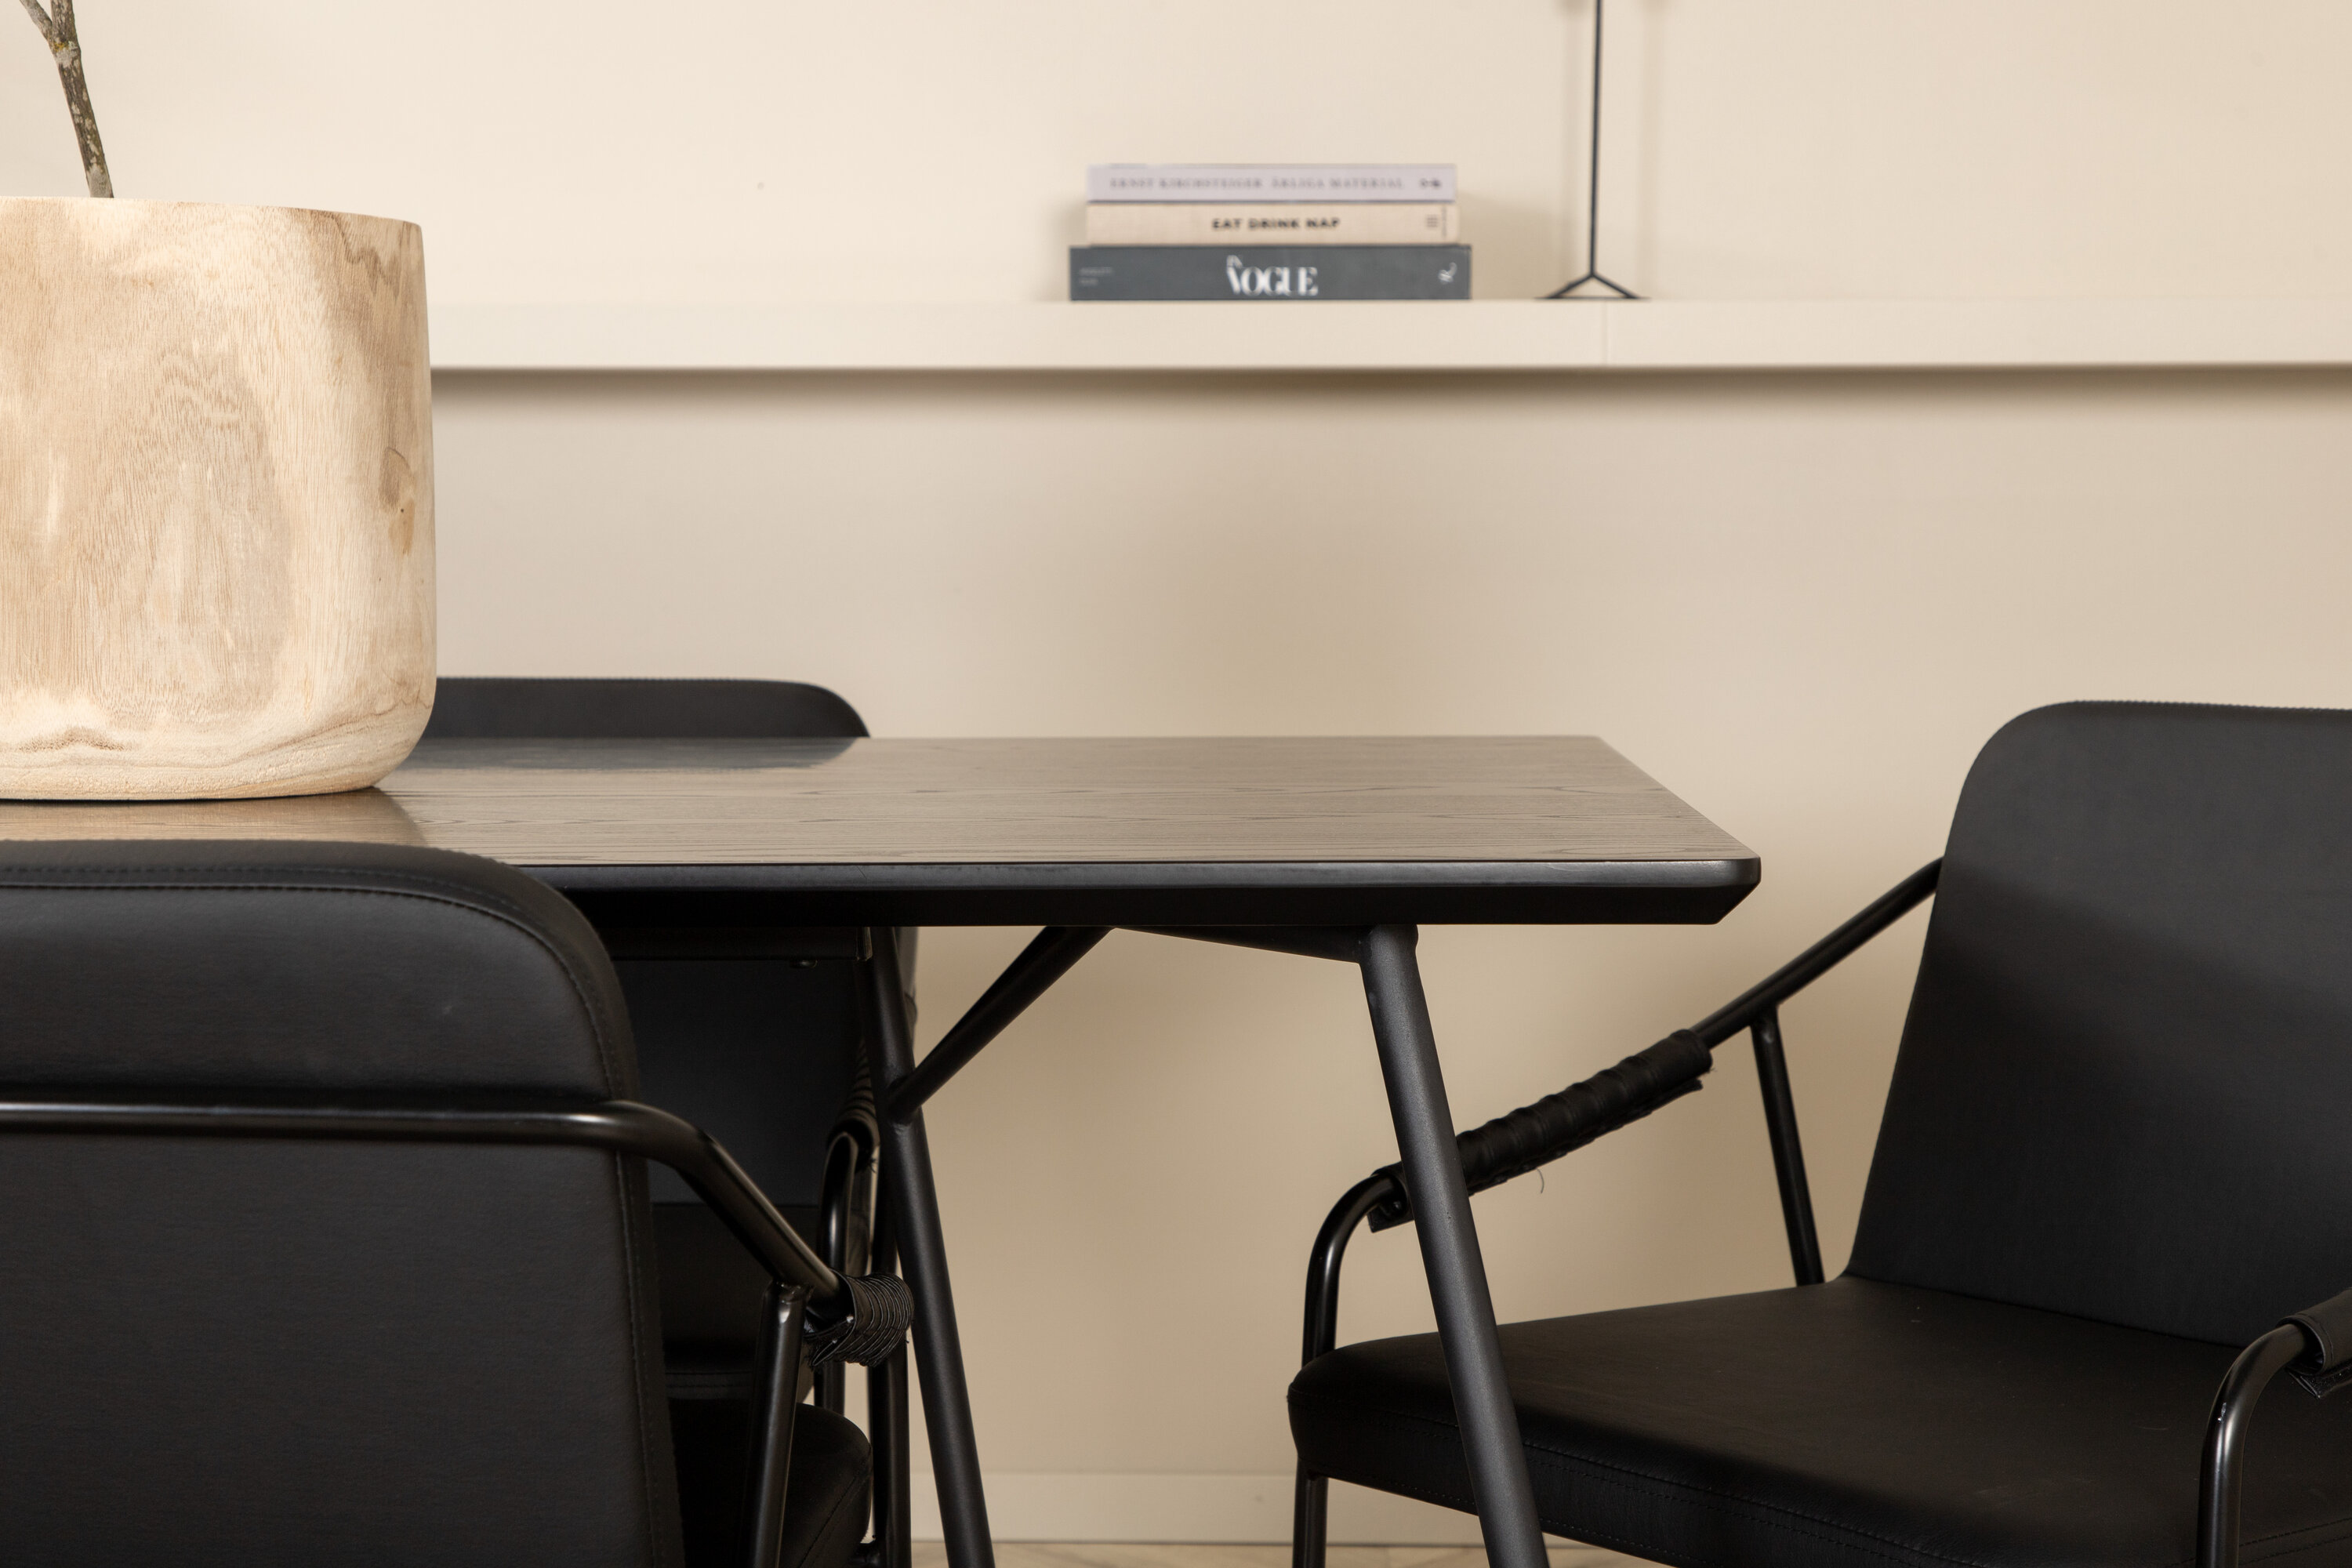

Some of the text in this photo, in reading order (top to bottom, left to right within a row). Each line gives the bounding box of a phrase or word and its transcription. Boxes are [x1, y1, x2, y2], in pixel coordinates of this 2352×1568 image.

[1211, 216, 1341, 230] EAT DRINK NAP
[1226, 266, 1319, 296] VOGUE
